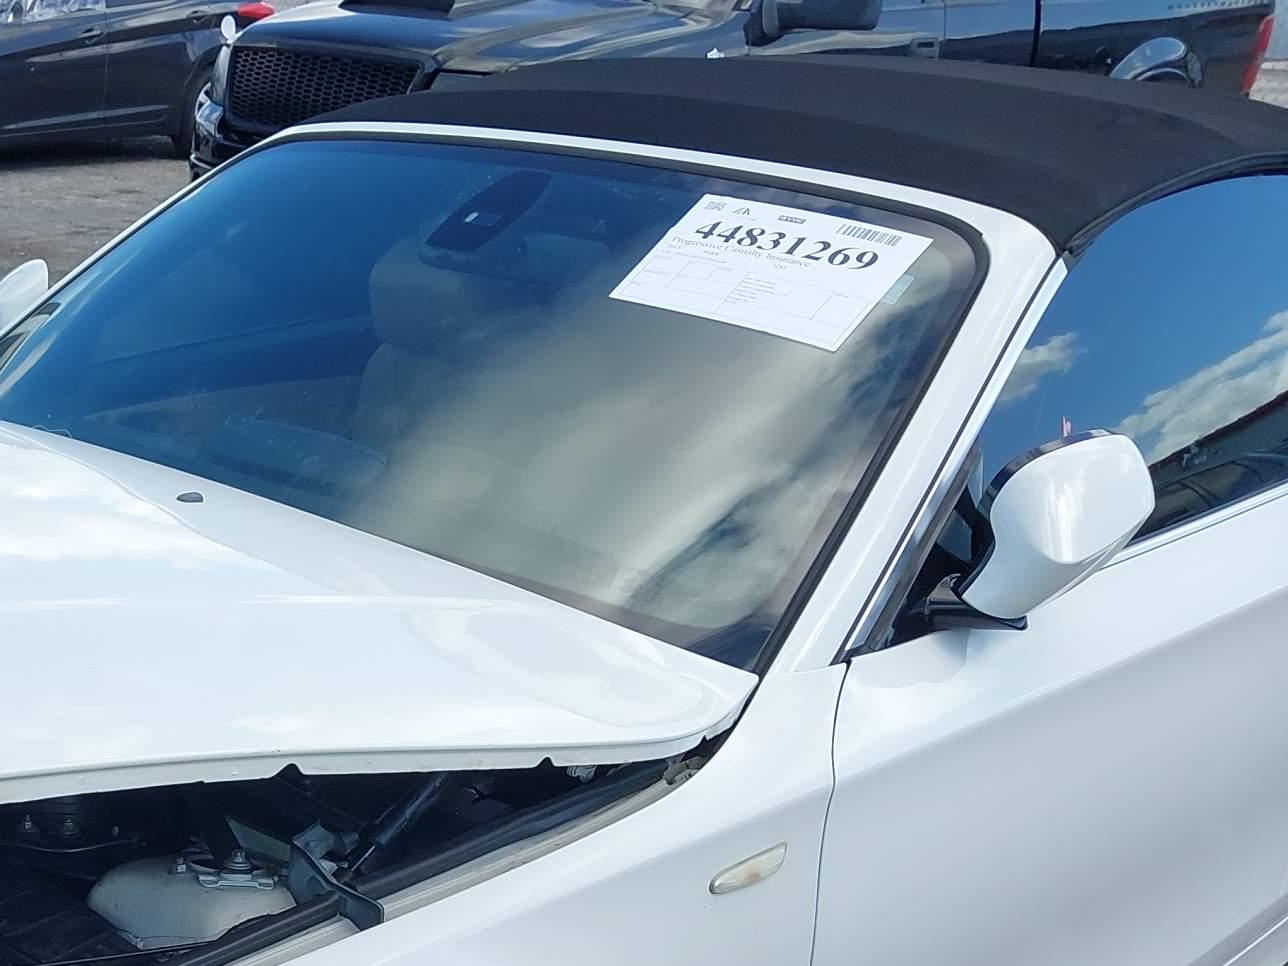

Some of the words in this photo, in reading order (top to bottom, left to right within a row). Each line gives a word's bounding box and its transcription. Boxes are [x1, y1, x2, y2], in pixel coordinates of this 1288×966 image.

[671, 235, 725, 251] Progressive
[724, 244, 763, 259] Casualty
[765, 251, 811, 267] Insurance
[694, 220, 880, 270] 44831269
